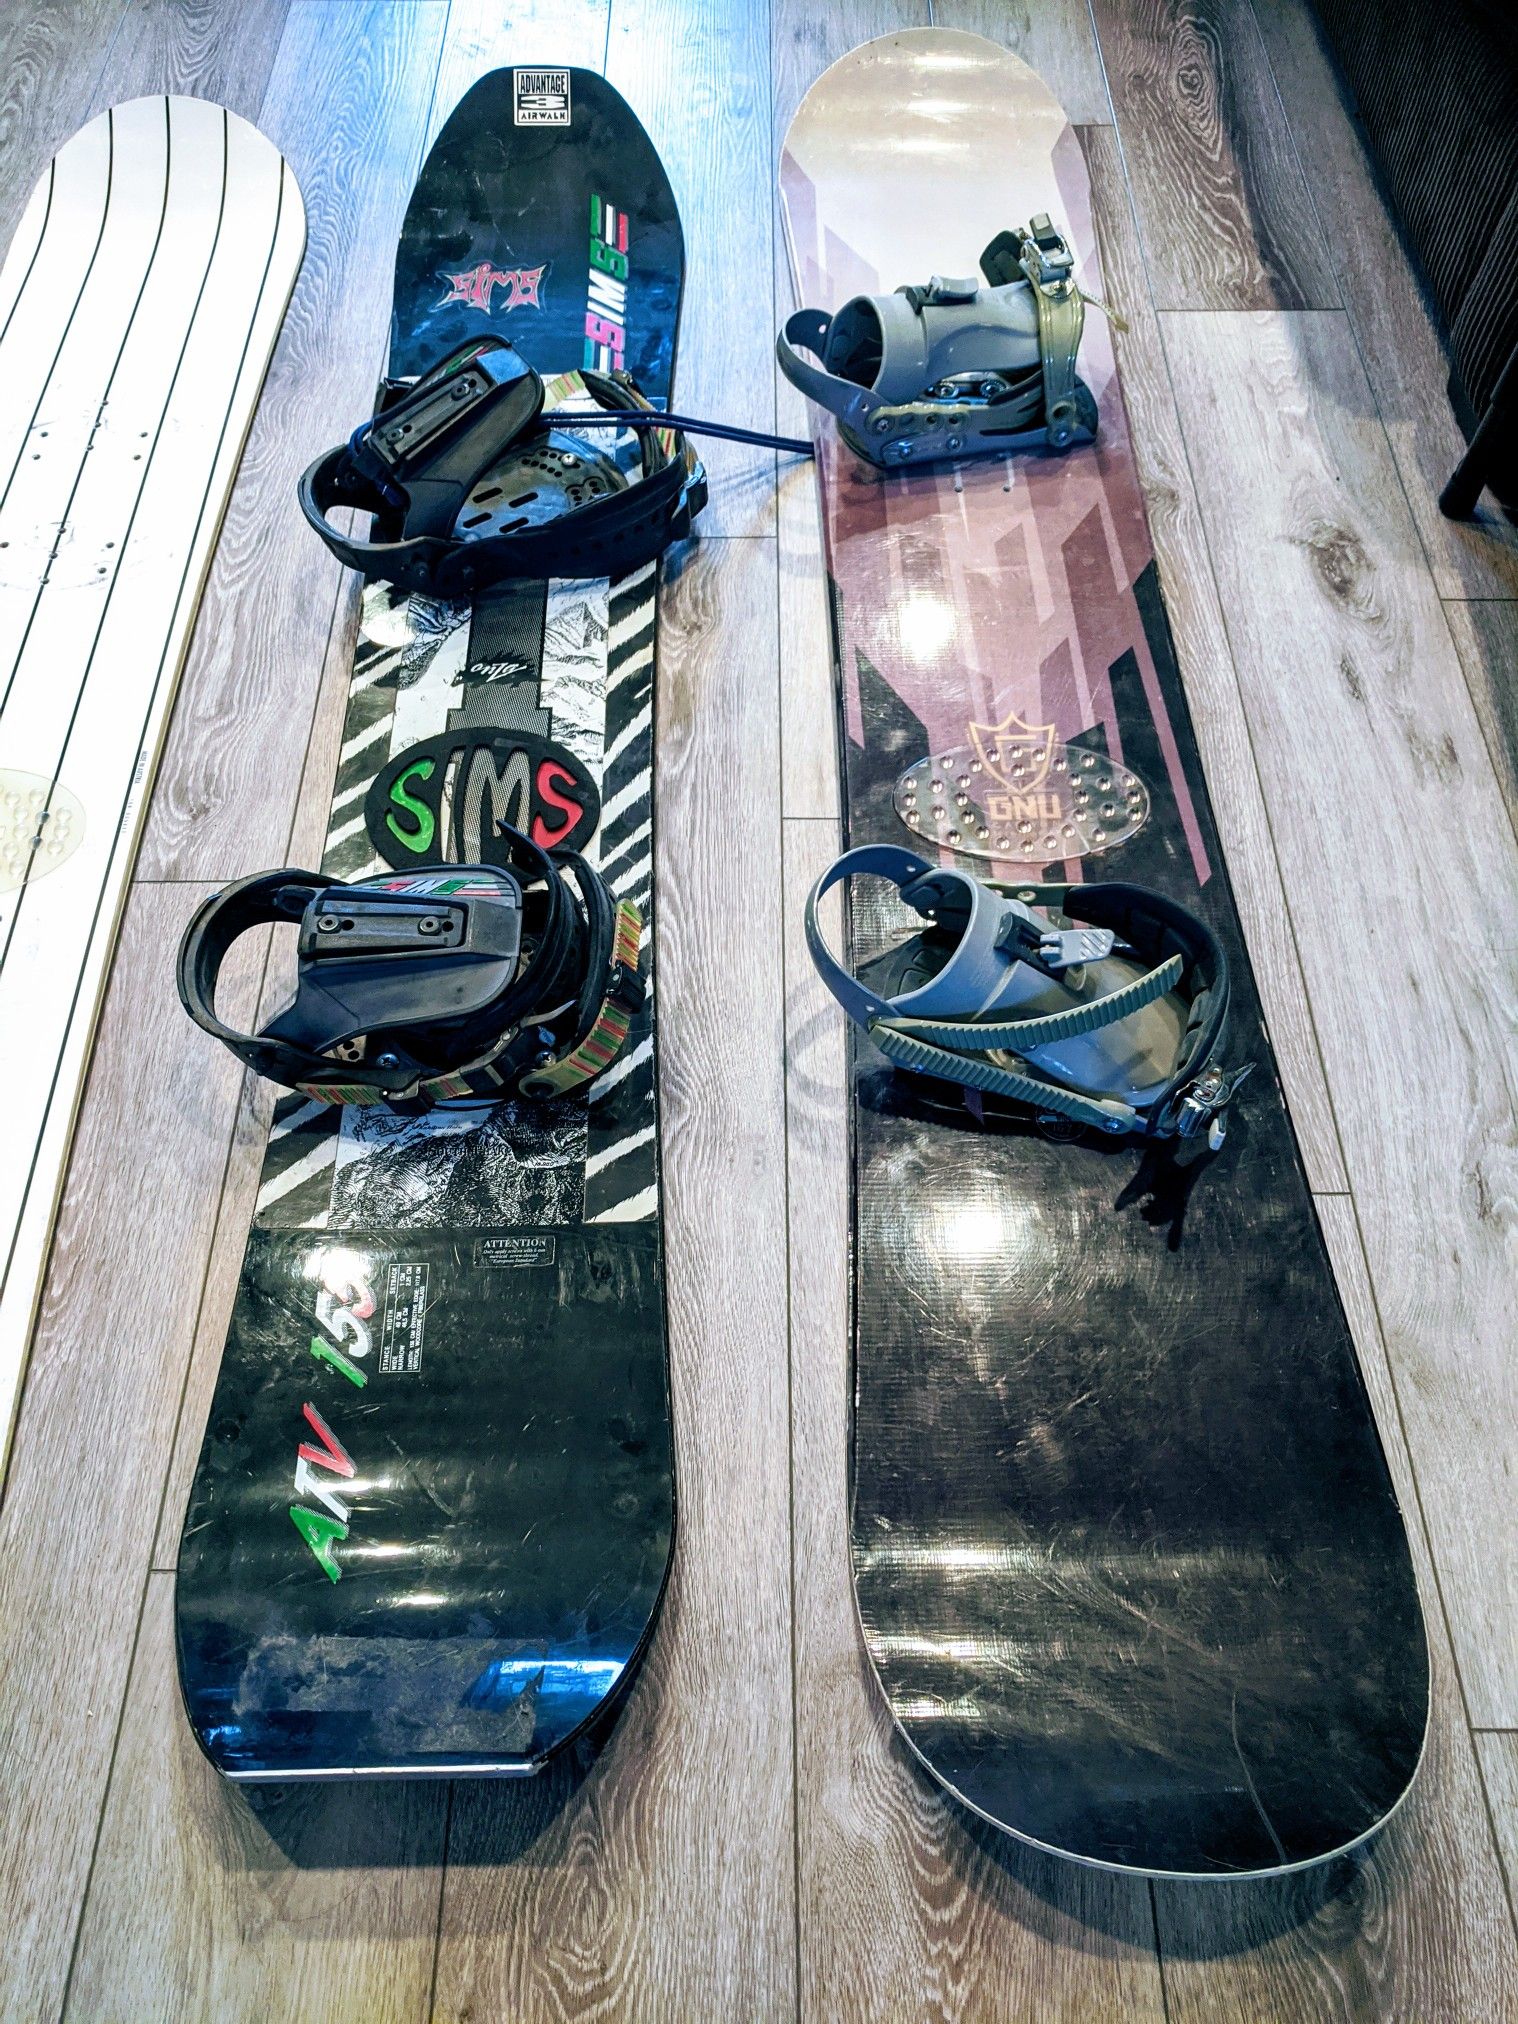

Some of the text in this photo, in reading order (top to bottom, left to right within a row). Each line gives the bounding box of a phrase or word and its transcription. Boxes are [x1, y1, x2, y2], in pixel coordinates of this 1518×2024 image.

[520, 74, 565, 94] ADVANTAGE
[520, 111, 566, 120] AIRWALK
[434, 262, 547, 316] SIMS
[585, 237, 629, 353] SIMS
[385, 744, 584, 866] SIMS
[986, 794, 1062, 820] GNU
[483, 1239, 546, 1248] ATTENTION
[386, 1310, 394, 1331] WIDTH
[390, 1268, 398, 1294] SETBACK
[397, 1312, 402, 1320] CM
[400, 1273, 406, 1281] CM
[403, 1308, 409, 1316] CM
[407, 1266, 413, 1274] CM
[289, 1401, 358, 1584] ATV
